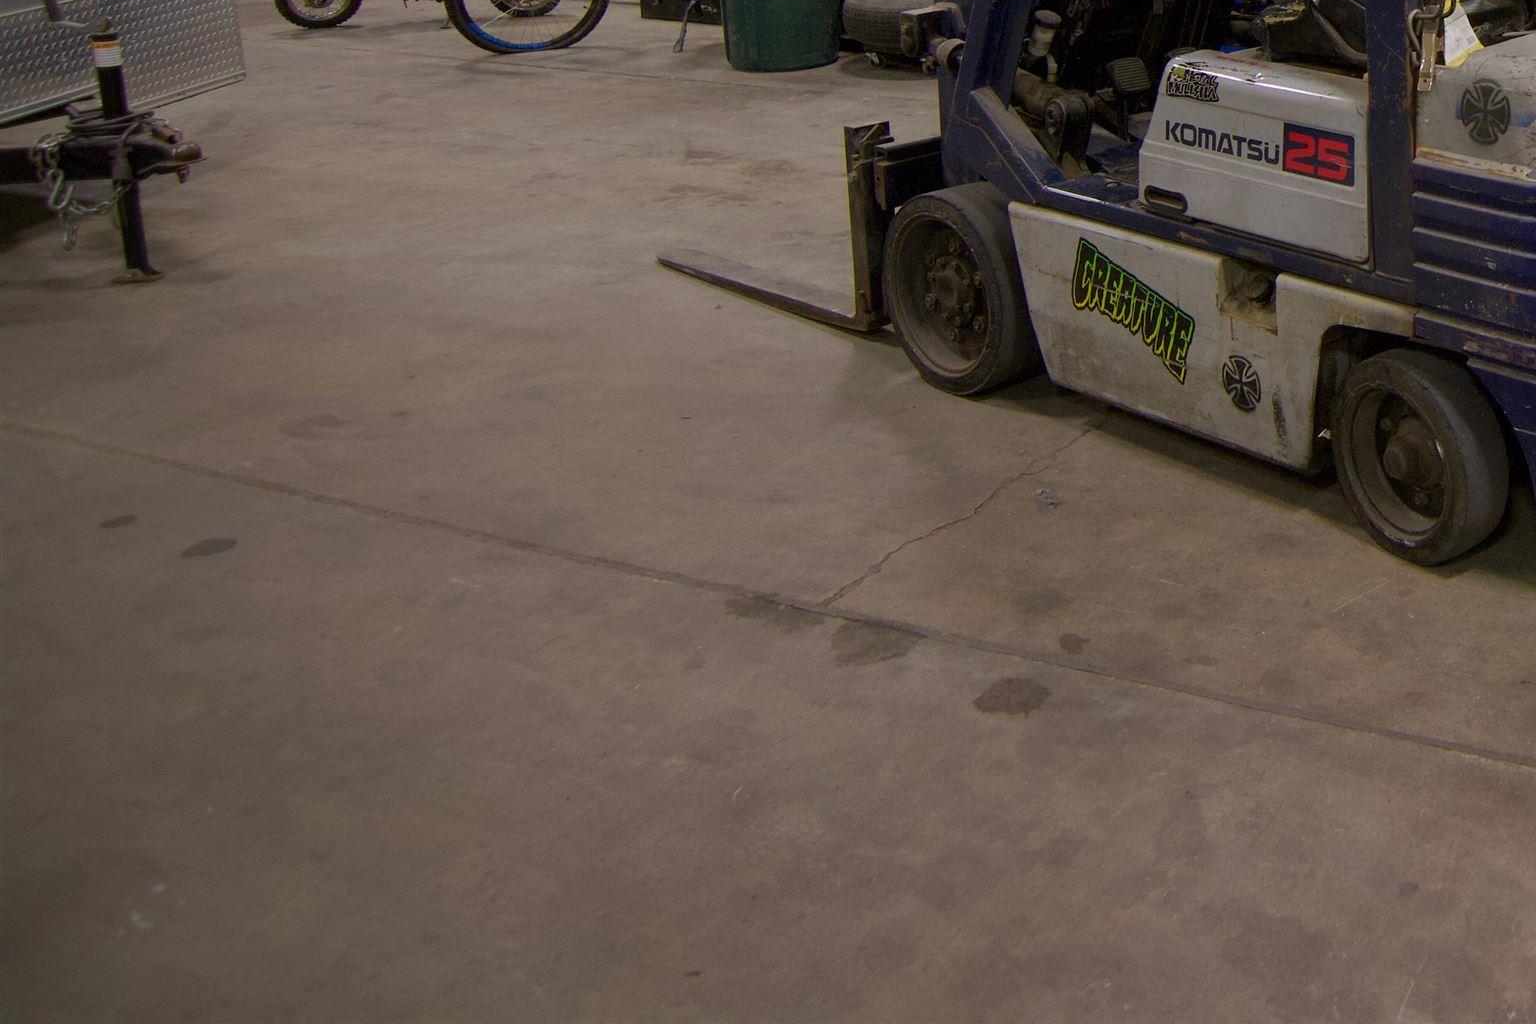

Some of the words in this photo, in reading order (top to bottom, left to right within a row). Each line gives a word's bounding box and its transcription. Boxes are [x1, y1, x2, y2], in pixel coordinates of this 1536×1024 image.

[1165, 120, 1280, 166] KOMATSU
[1285, 131, 1351, 182] 25
[1072, 236, 1196, 386] CREATURE
